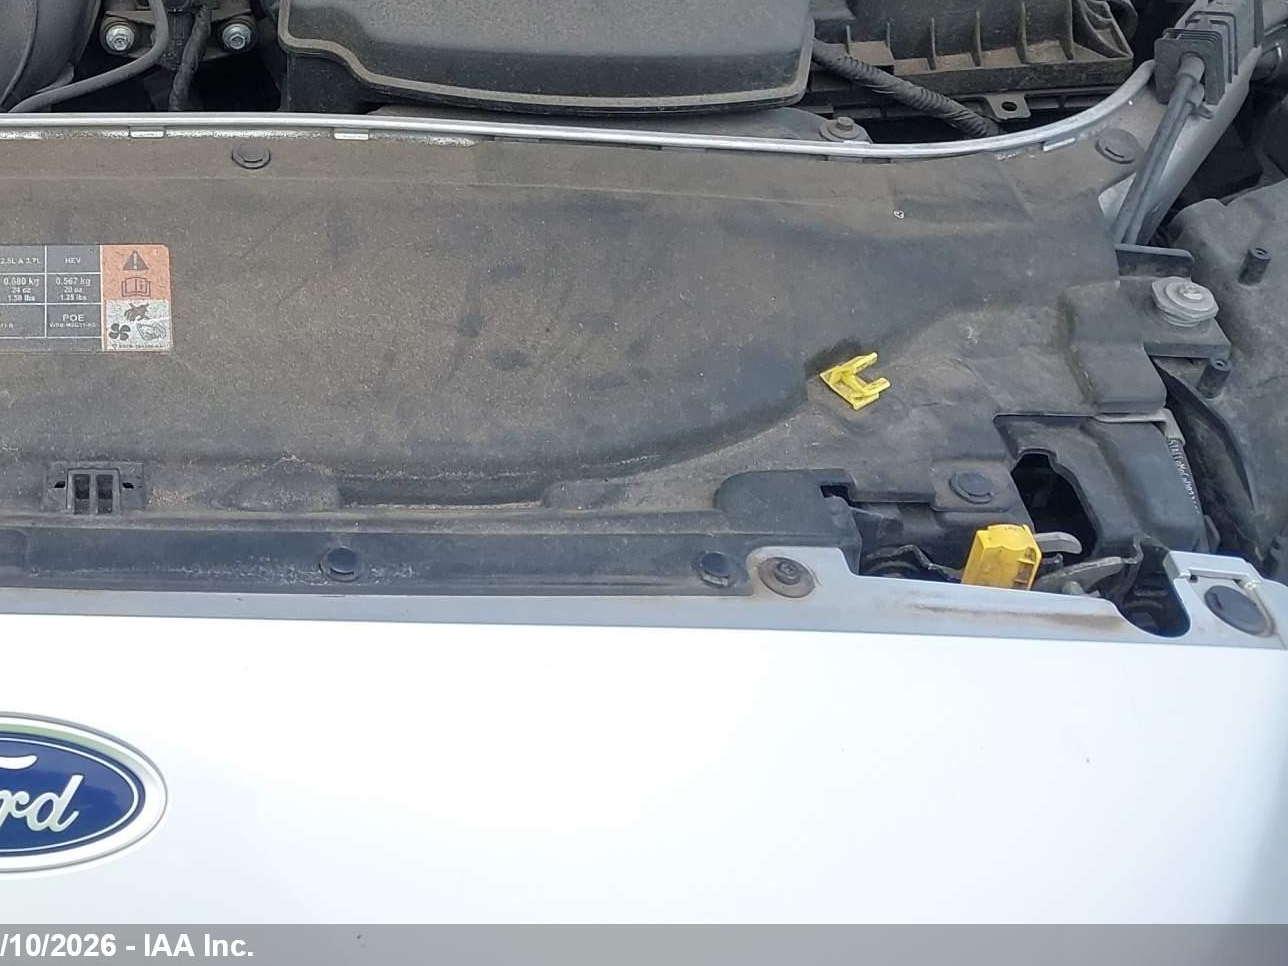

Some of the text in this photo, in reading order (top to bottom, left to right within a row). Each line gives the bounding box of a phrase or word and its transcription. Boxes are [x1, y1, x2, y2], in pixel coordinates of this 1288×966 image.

[65, 257, 81, 265] HEV
[28, 277, 40, 287] kg
[55, 277, 91, 288] 0.567 kg
[62, 313, 85, 322] POE
